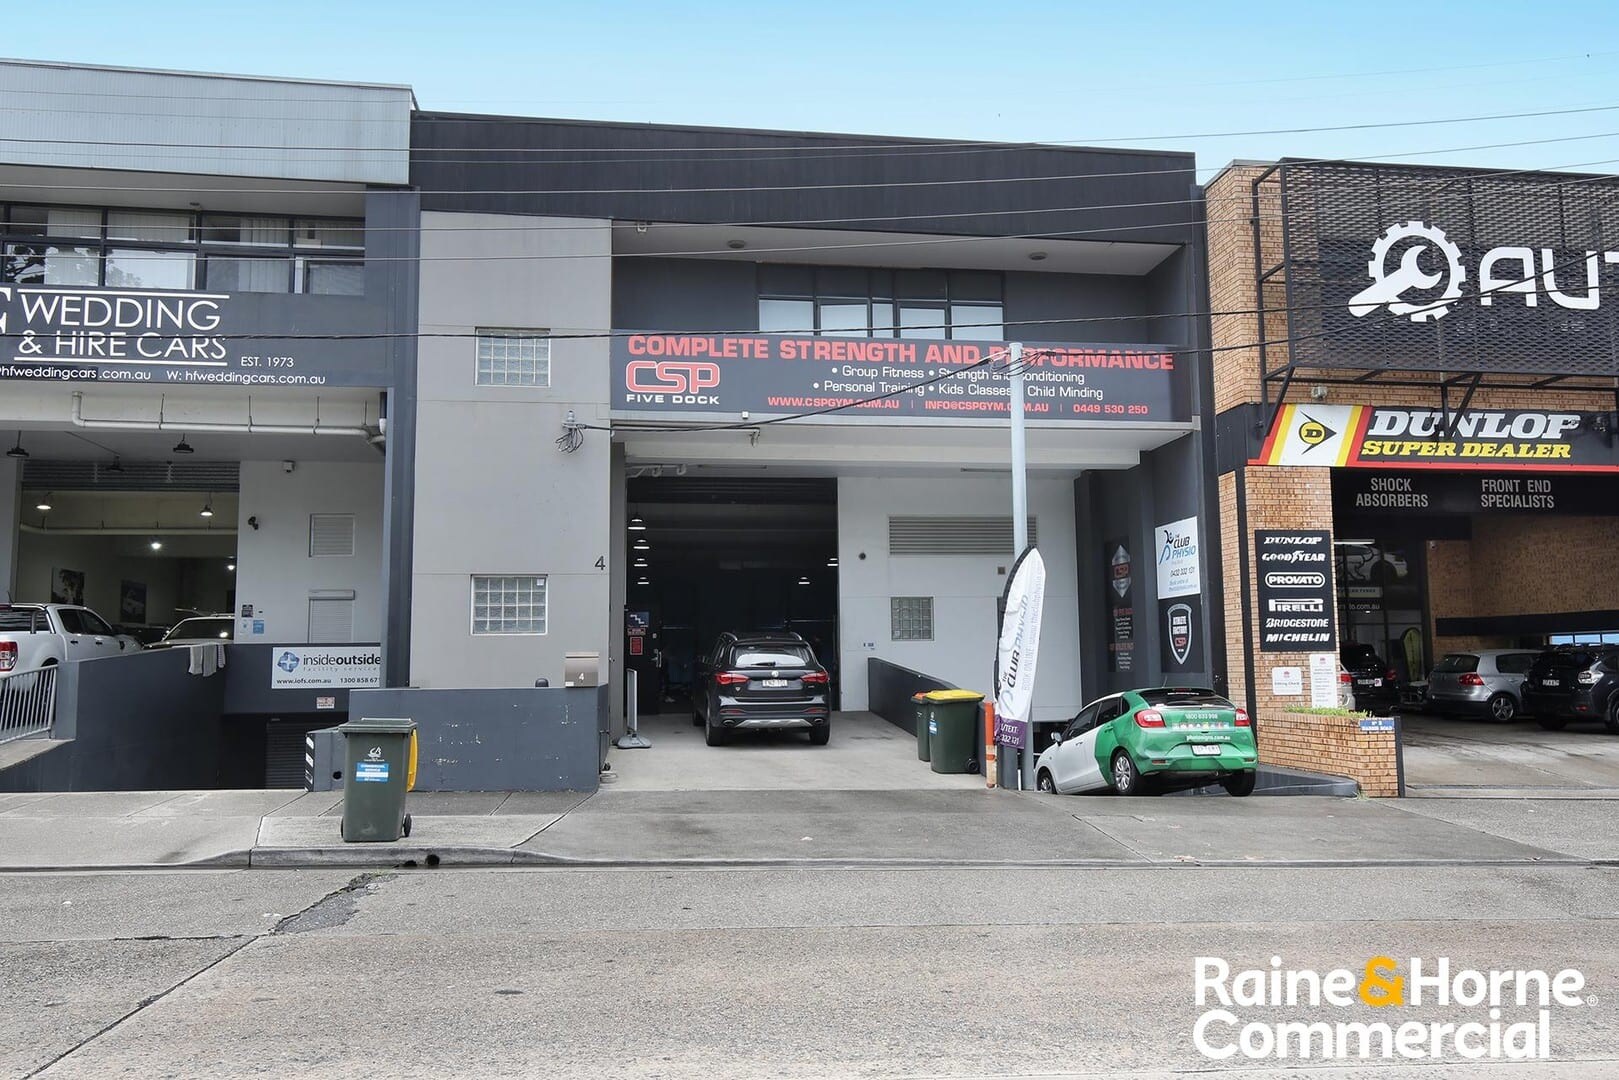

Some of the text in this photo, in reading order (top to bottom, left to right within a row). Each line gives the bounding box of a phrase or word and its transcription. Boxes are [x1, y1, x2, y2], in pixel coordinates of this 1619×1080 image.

[21, 294, 220, 331] WEDDING
[19, 330, 227, 360] & HIRE CARS
[628, 334, 769, 359] COMPLETE
[780, 338, 916, 363] STRENGTH
[924, 344, 981, 366] AND
[241, 356, 294, 368] EST. 1973
[167, 370, 182, 381] W:
[185, 370, 326, 385] hfweddingcars.com.au
[625, 360, 721, 394] CSP
[842, 365, 878, 379] Group
[882, 366, 924, 378] Fitness
[1022, 371, 1085, 385] onditioning
[824, 381, 875, 393] Personal
[879, 381, 925, 396] Training
[938, 383, 964, 395] Kids
[1027, 385, 1055, 397] Child
[1059, 386, 1103, 400] Minding
[626, 394, 720, 405] FIVE DOCK
[1073, 403, 1101, 414] 0449
[1104, 404, 1125, 414] 530
[1128, 404, 1148, 415] 250
[1367, 410, 1581, 439] DUNLOP
[1361, 440, 1571, 458] SUPER DEALER
[1371, 477, 1412, 492] SHOCK
[1481, 479, 1551, 493] FRONT END
[1355, 493, 1429, 507] ABSORBERS
[1480, 494, 1555, 509] SPECIALISTS
[1173, 536, 1191, 549] CLUB
[1263, 536, 1323, 545] DUNLOP
[1171, 544, 1196, 560] PHYSIO
[594, 555, 606, 571] 4
[1268, 575, 1322, 585] PROVATO
[1268, 598, 1324, 612] PIRELLI
[1265, 617, 1329, 628] BRIDGESTONE
[1265, 633, 1330, 643] MICHELIN
[303, 653, 380, 666] insideoutside
[578, 672, 585, 681] 4
